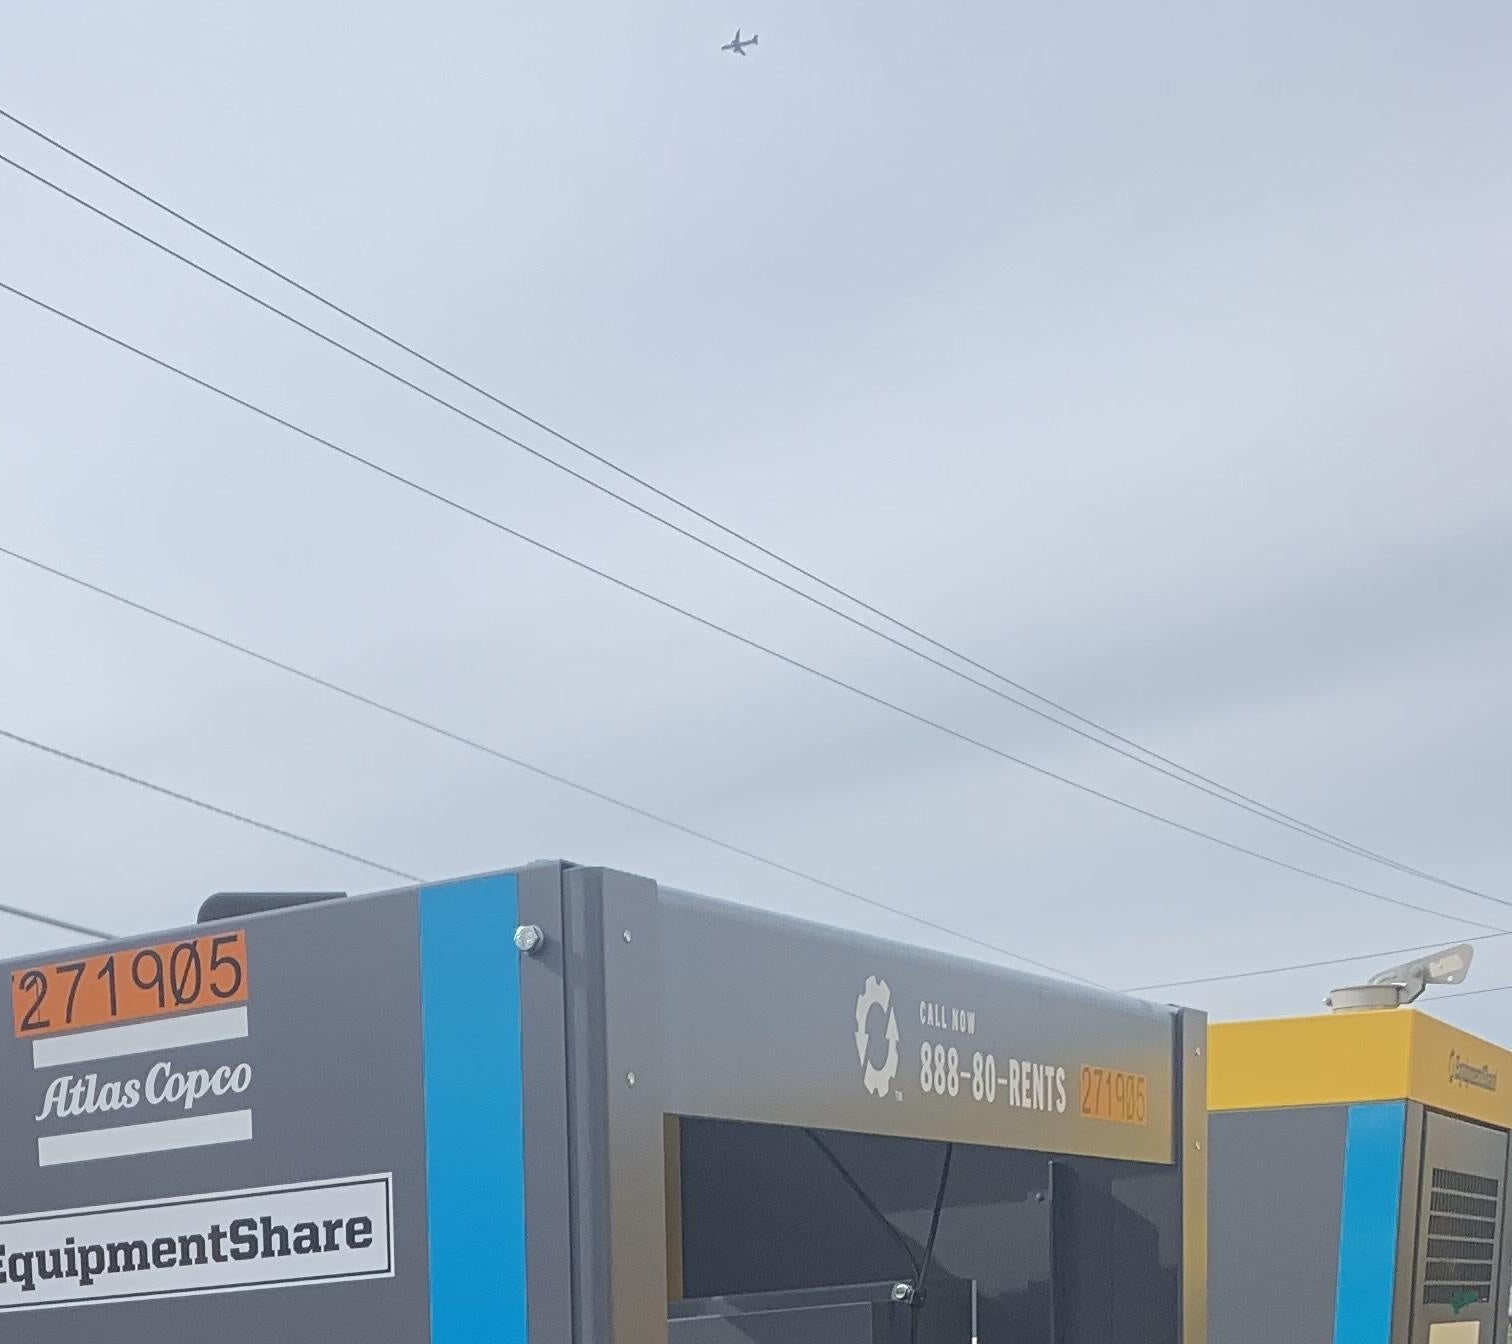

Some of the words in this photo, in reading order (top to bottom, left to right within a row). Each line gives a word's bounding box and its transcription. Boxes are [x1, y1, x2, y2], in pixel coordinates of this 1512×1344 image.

[19, 935, 242, 1031] 271905
[919, 1000, 947, 1029] CALL
[952, 1007, 976, 1035] NOW
[35, 1073, 140, 1121] Atlas
[145, 1061, 252, 1109] Copco
[920, 1041, 1067, 1114] 888-80-RENTS
[1082, 1067, 1146, 1122] 271905
